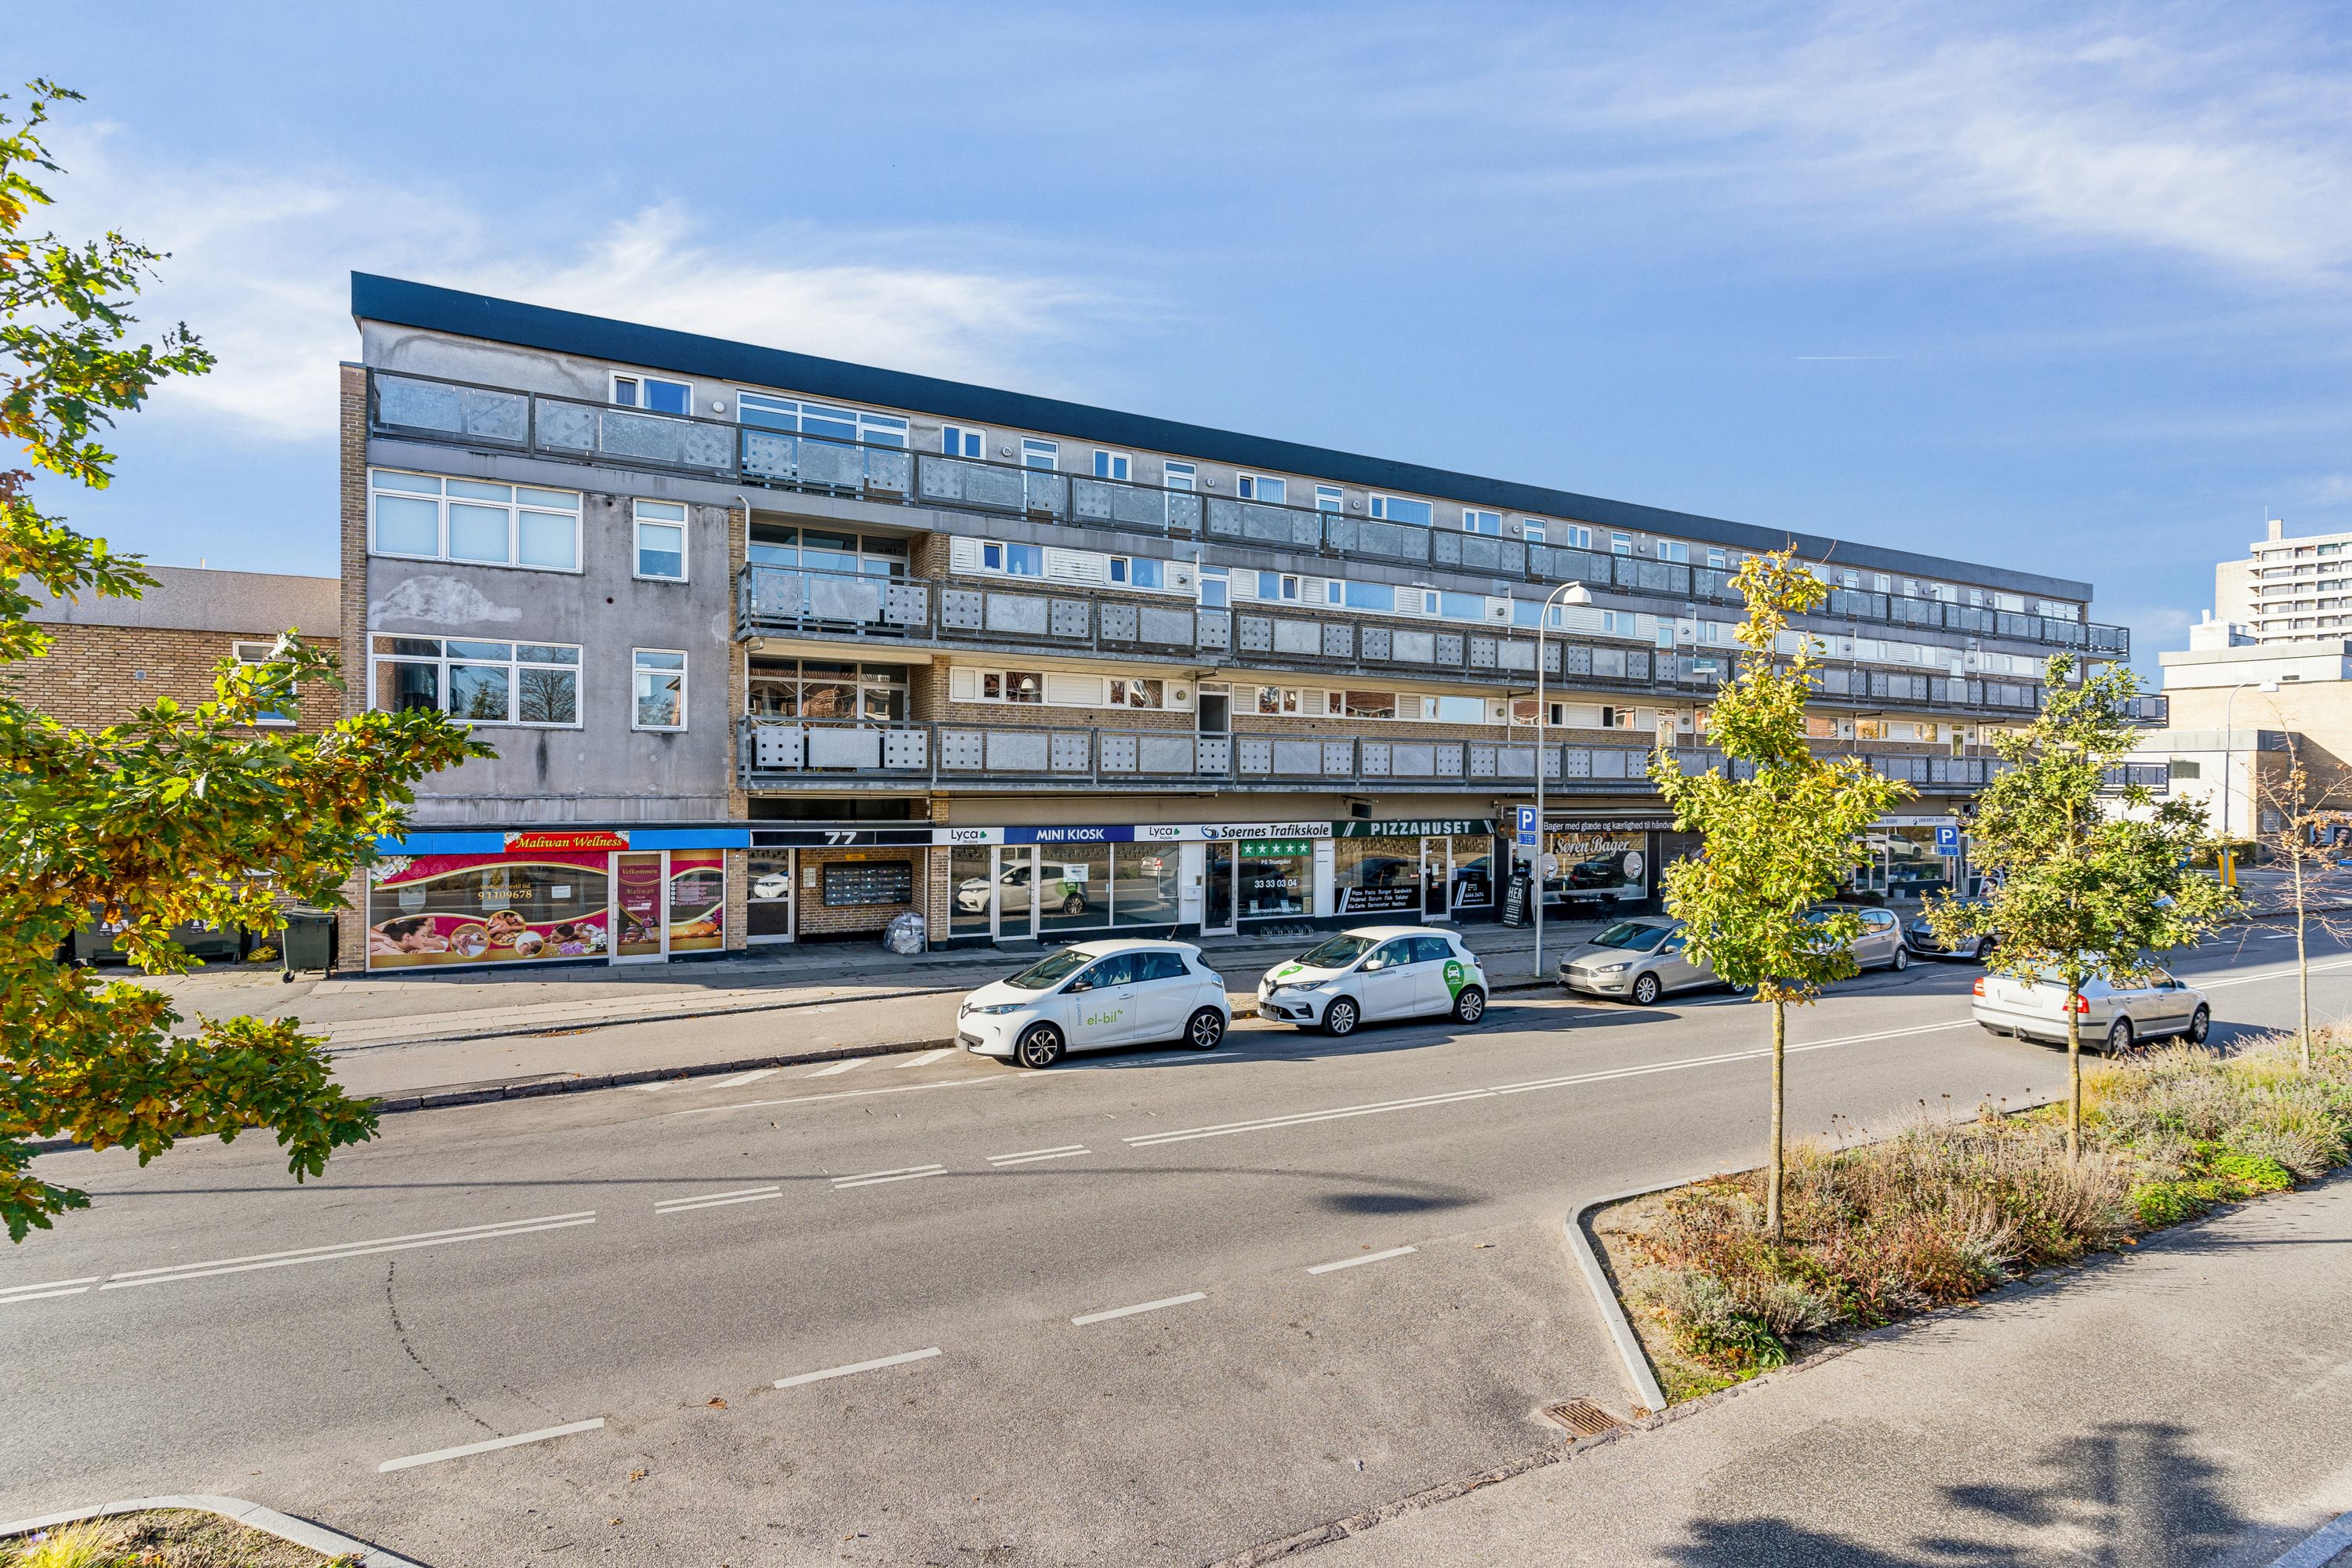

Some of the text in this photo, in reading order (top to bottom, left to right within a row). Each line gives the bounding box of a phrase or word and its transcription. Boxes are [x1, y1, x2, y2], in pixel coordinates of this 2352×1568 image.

[1523, 811, 1533, 829] P
[1544, 822, 1564, 832] Bager
[1565, 822, 1580, 830] med
[1581, 821, 1602, 832] glæde
[1612, 821, 1642, 831] kærlighed
[950, 829, 978, 841] Lyca
[1036, 829, 1105, 841] MINI KIOSK
[1149, 826, 1172, 837] Lyca
[1221, 823, 1329, 838] Søernes Trafikskole
[1370, 821, 1471, 836] PIZZAHUSET
[515, 835, 622, 848] Maliwan Wellness
[825, 831, 857, 845] 77
[1941, 829, 1954, 844] P
[1555, 835, 1630, 858] Søren Bager
[1254, 880, 1265, 888] 33
[1276, 879, 1286, 887] 03
[1508, 886, 1523, 900] HER
[1368, 969, 1396, 978] GreenMobility
[1087, 1011, 1116, 1025] el-bil
